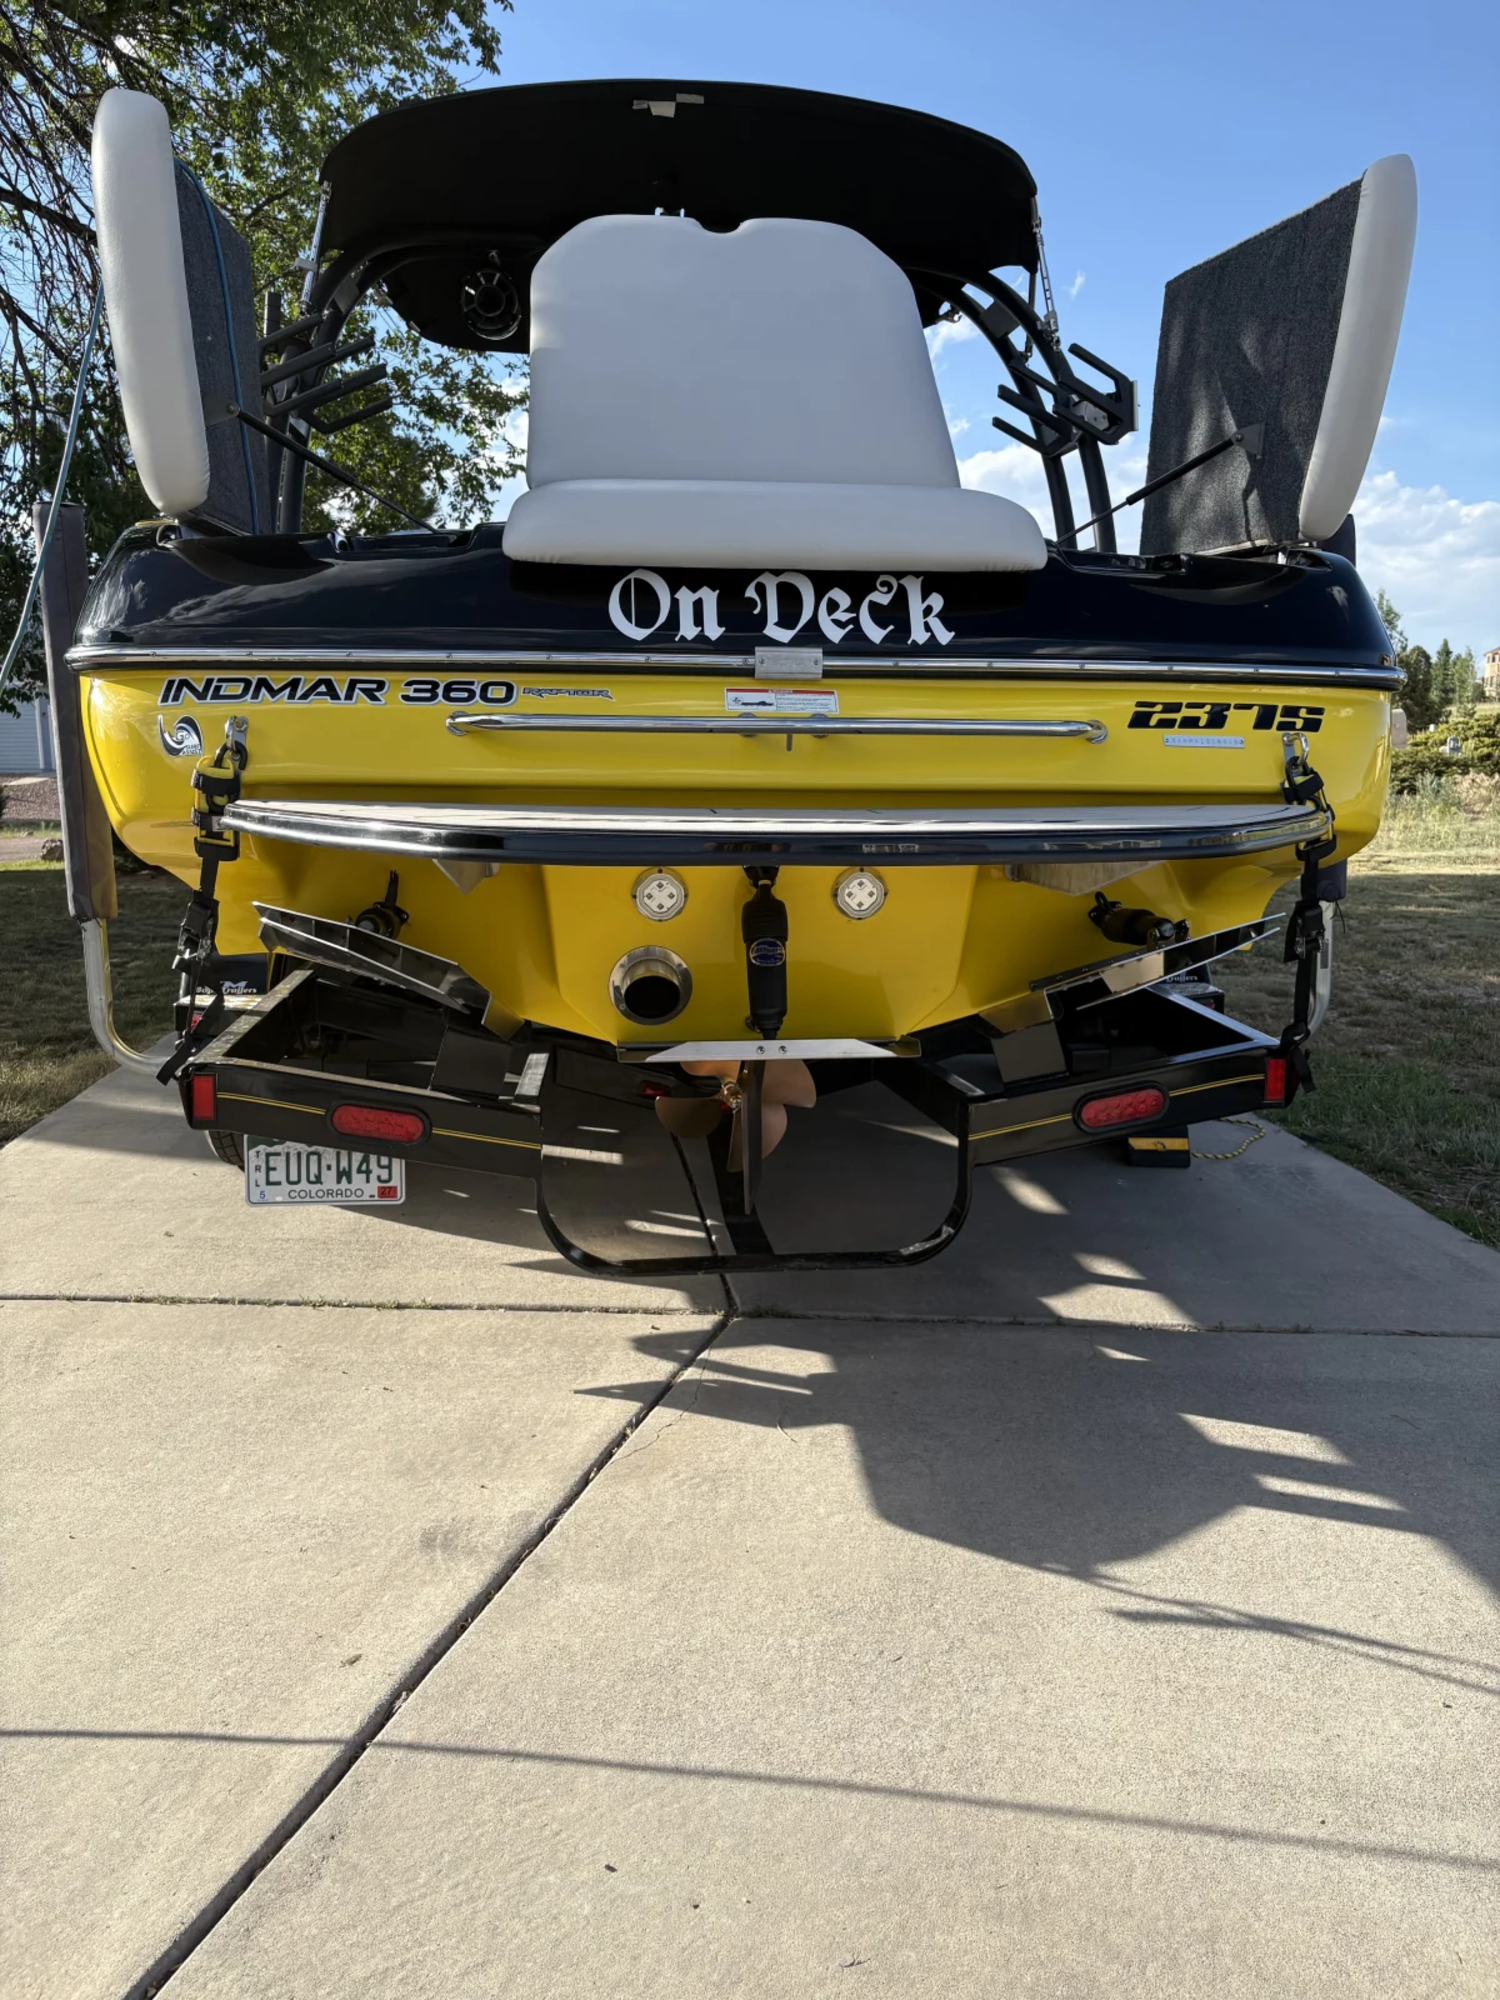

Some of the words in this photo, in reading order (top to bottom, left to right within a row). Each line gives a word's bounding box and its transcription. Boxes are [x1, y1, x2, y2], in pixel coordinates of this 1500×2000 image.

[608, 568, 726, 641] On
[744, 571, 956, 645] Deck
[158, 676, 389, 706] INDMAR
[399, 679, 518, 708] 360
[522, 687, 615, 701] RAPTOR
[259, 1190, 266, 1199] 5
[288, 1188, 364, 1199] COLORADO
[381, 1186, 392, 1196] 27
